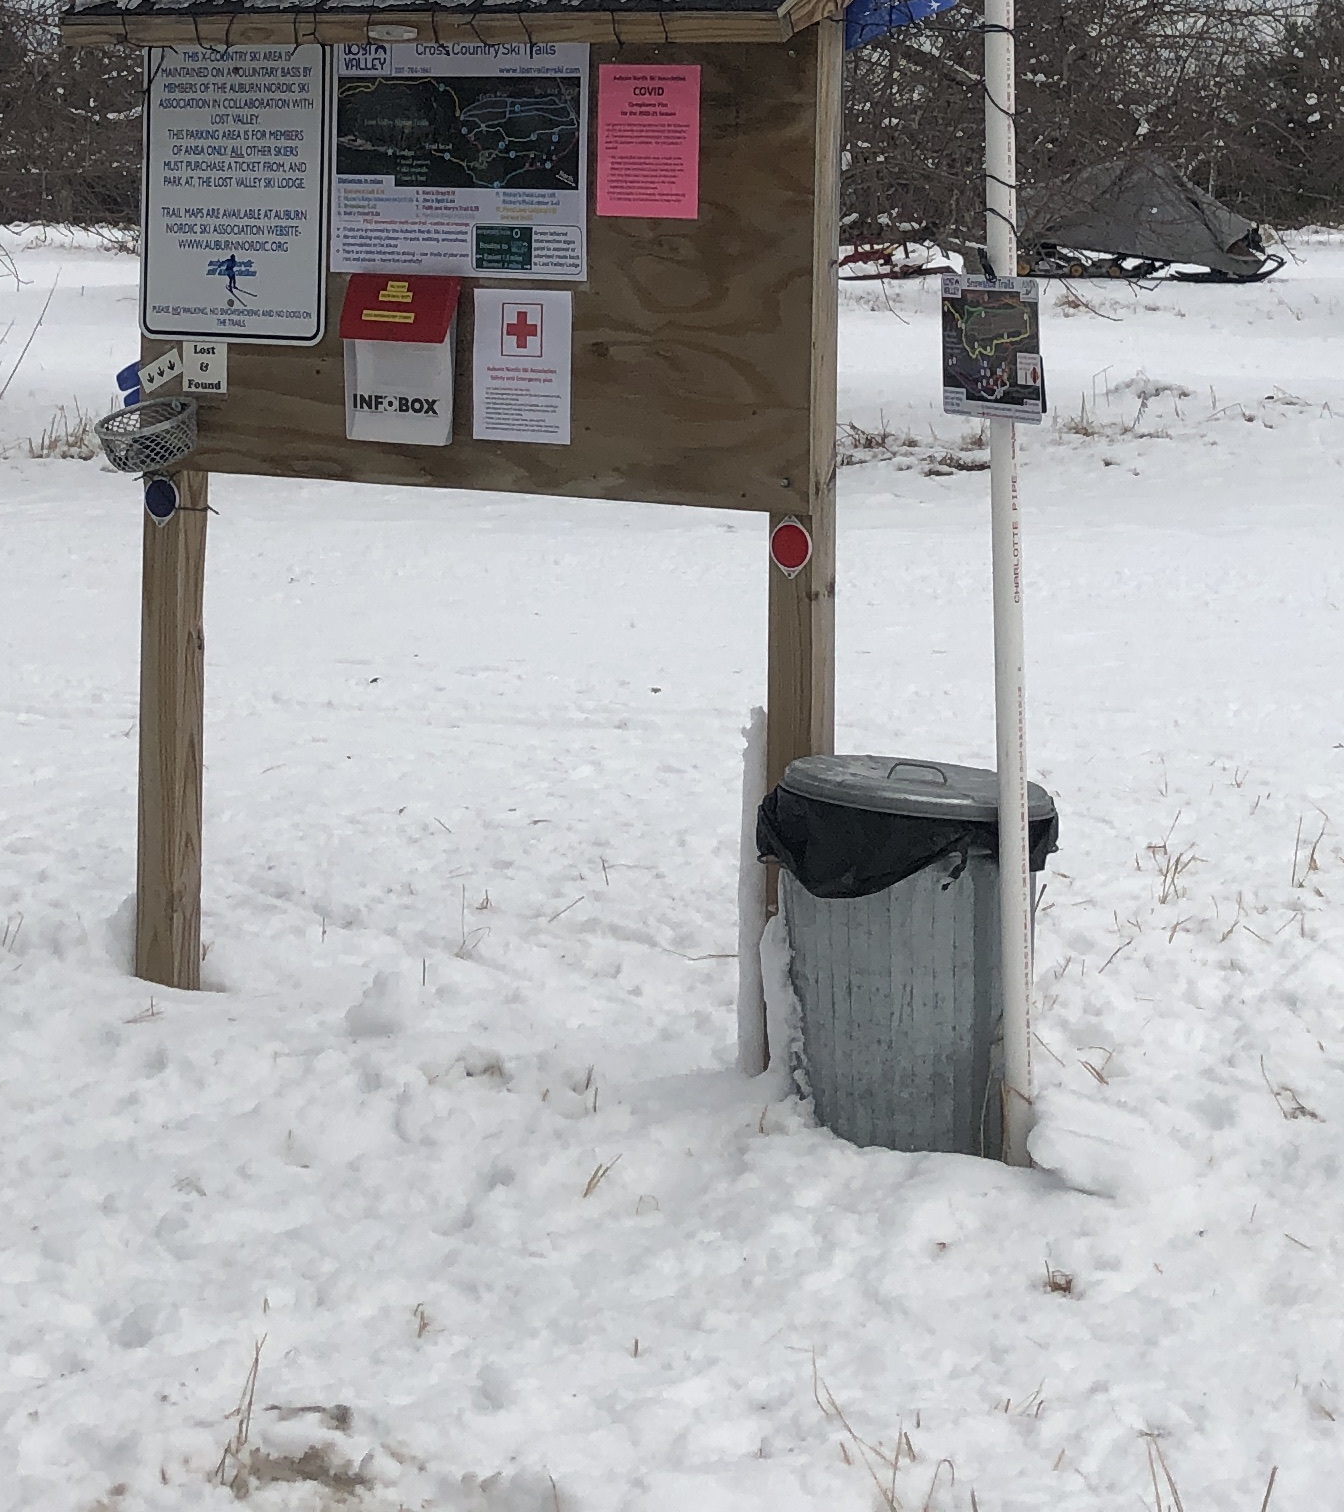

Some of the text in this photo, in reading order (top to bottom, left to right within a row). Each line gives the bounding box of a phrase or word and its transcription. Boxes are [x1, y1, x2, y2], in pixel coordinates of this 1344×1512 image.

[183, 51, 291, 62] THIS X-COUNTRY SKI AREA IS
[415, 44, 449, 56] Cross
[452, 44, 500, 58] Country
[502, 44, 520, 56] Ski
[344, 58, 386, 70] VALLEY
[161, 67, 312, 77] MAINTAINED ON A VOLUNTARY BASIS BY
[499, 66, 581, 75] www.lostvalleyski.com
[164, 83, 309, 93] MEMBERS OF THE AUBURN NORDIC SKI
[633, 87, 665, 96] COVID
[159, 98, 314, 109] ASSOCIATION IN COLLABORATION WITH
[211, 114, 230, 124] LOST
[168, 130, 304, 140] THIS PARKING AREA IS FOR MEMBERS
[172, 145, 183, 155] OF
[184, 145, 205, 156] ANSA
[230, 146, 244, 157] ALL
[246, 146, 272, 156] OTHER
[274, 146, 298, 156] SKIERS
[164, 161, 306, 173] MUST PURCHASE A TICKET FROM, AND
[164, 176, 182, 186] PARK
[198, 177, 212, 187] THE
[214, 177, 233, 187] LOST
[236, 177, 262, 187] VALLEY
[264, 177, 275, 188] SKI
[162, 207, 307, 220] TRAIL MAPS ARE AVAILABLE AT AUBURN
[166, 224, 197, 234] NORDIC
[199, 225, 211, 234] SKI
[213, 225, 264, 235] ASSOCIATION
[178, 239, 288, 252] WWW.AUBURNNORDIC.ORG
[998, 279, 1014, 289] Trails
[153, 306, 170, 314] PLEASE
[172, 306, 181, 315] NO
[262, 310, 274, 318] AND
[275, 310, 284, 318] NO
[286, 310, 301, 318] DOGS
[303, 311, 312, 319] ON
[193, 344, 216, 355] Lost
[199, 361, 210, 372] &
[187, 379, 221, 390] Found
